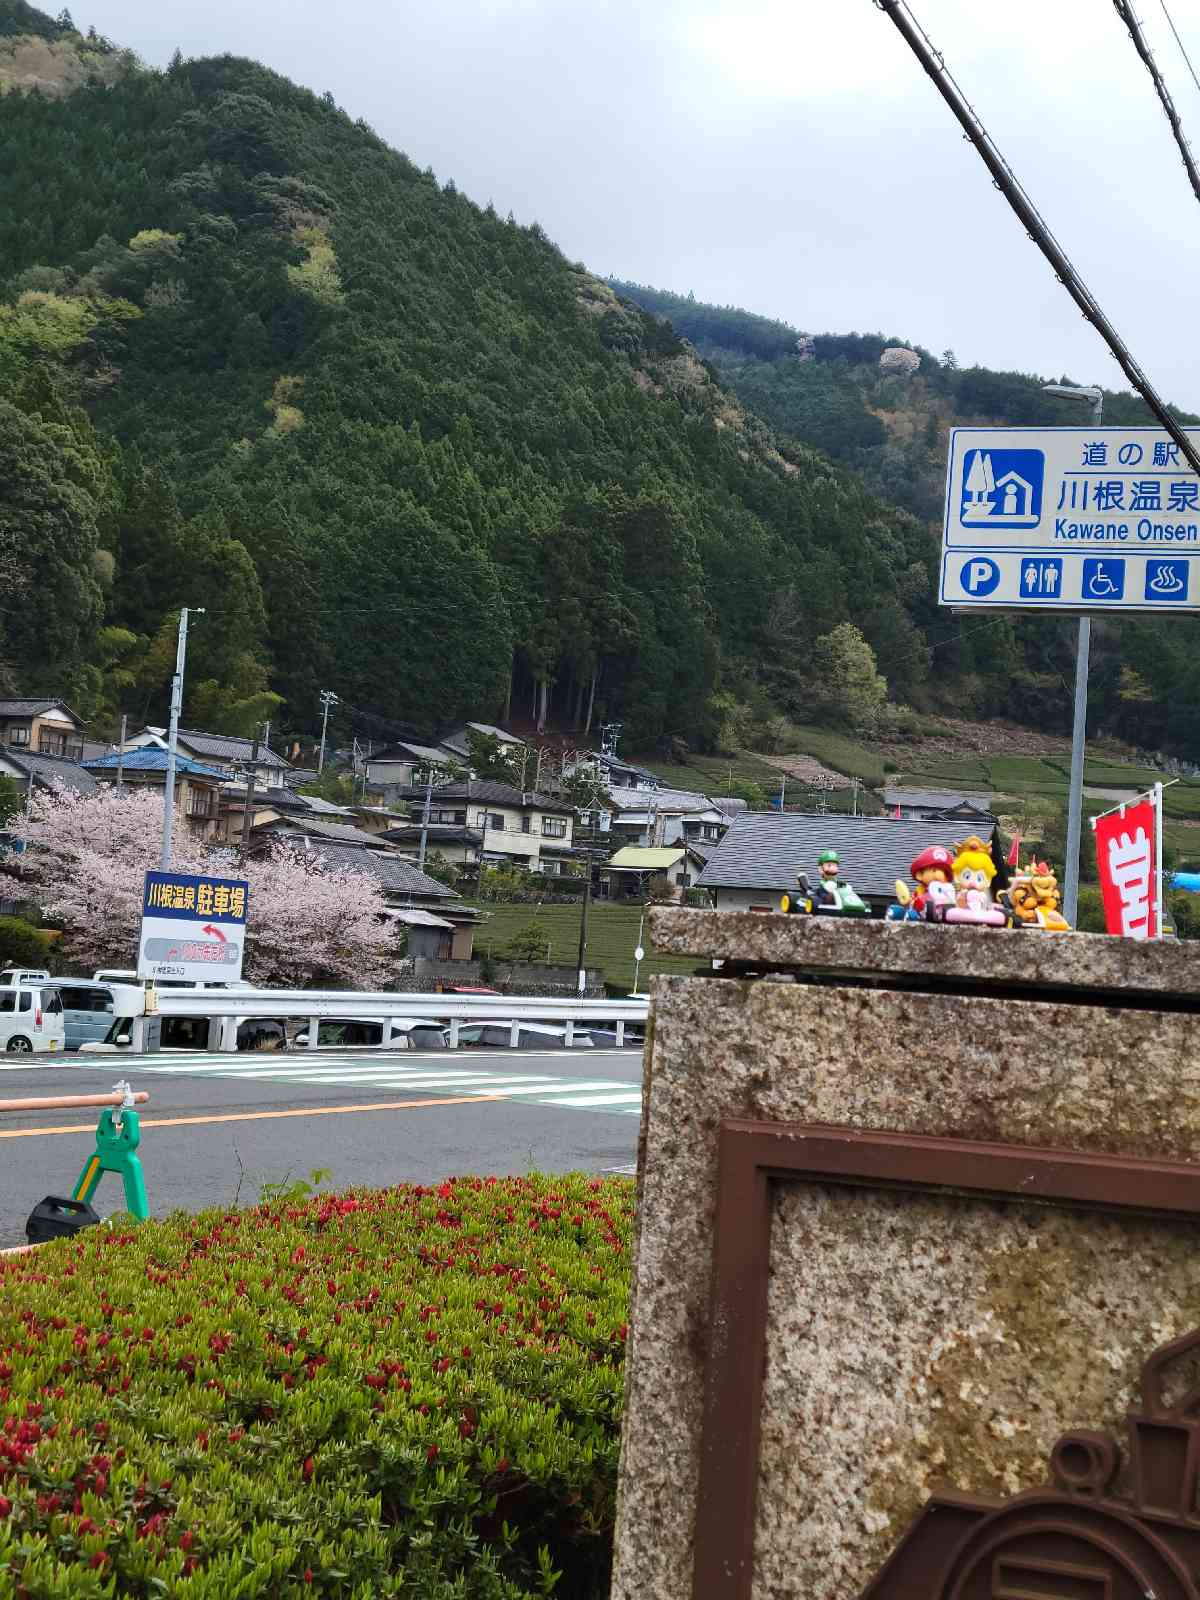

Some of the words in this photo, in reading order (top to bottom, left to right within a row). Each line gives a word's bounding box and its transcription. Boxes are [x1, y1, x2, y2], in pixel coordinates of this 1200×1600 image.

[1081, 441, 1180, 467] 道の駅
[1057, 480, 1200, 512] 川根温泉
[1055, 518, 1129, 541] Kawane
[1137, 518, 1198, 541] Onsen
